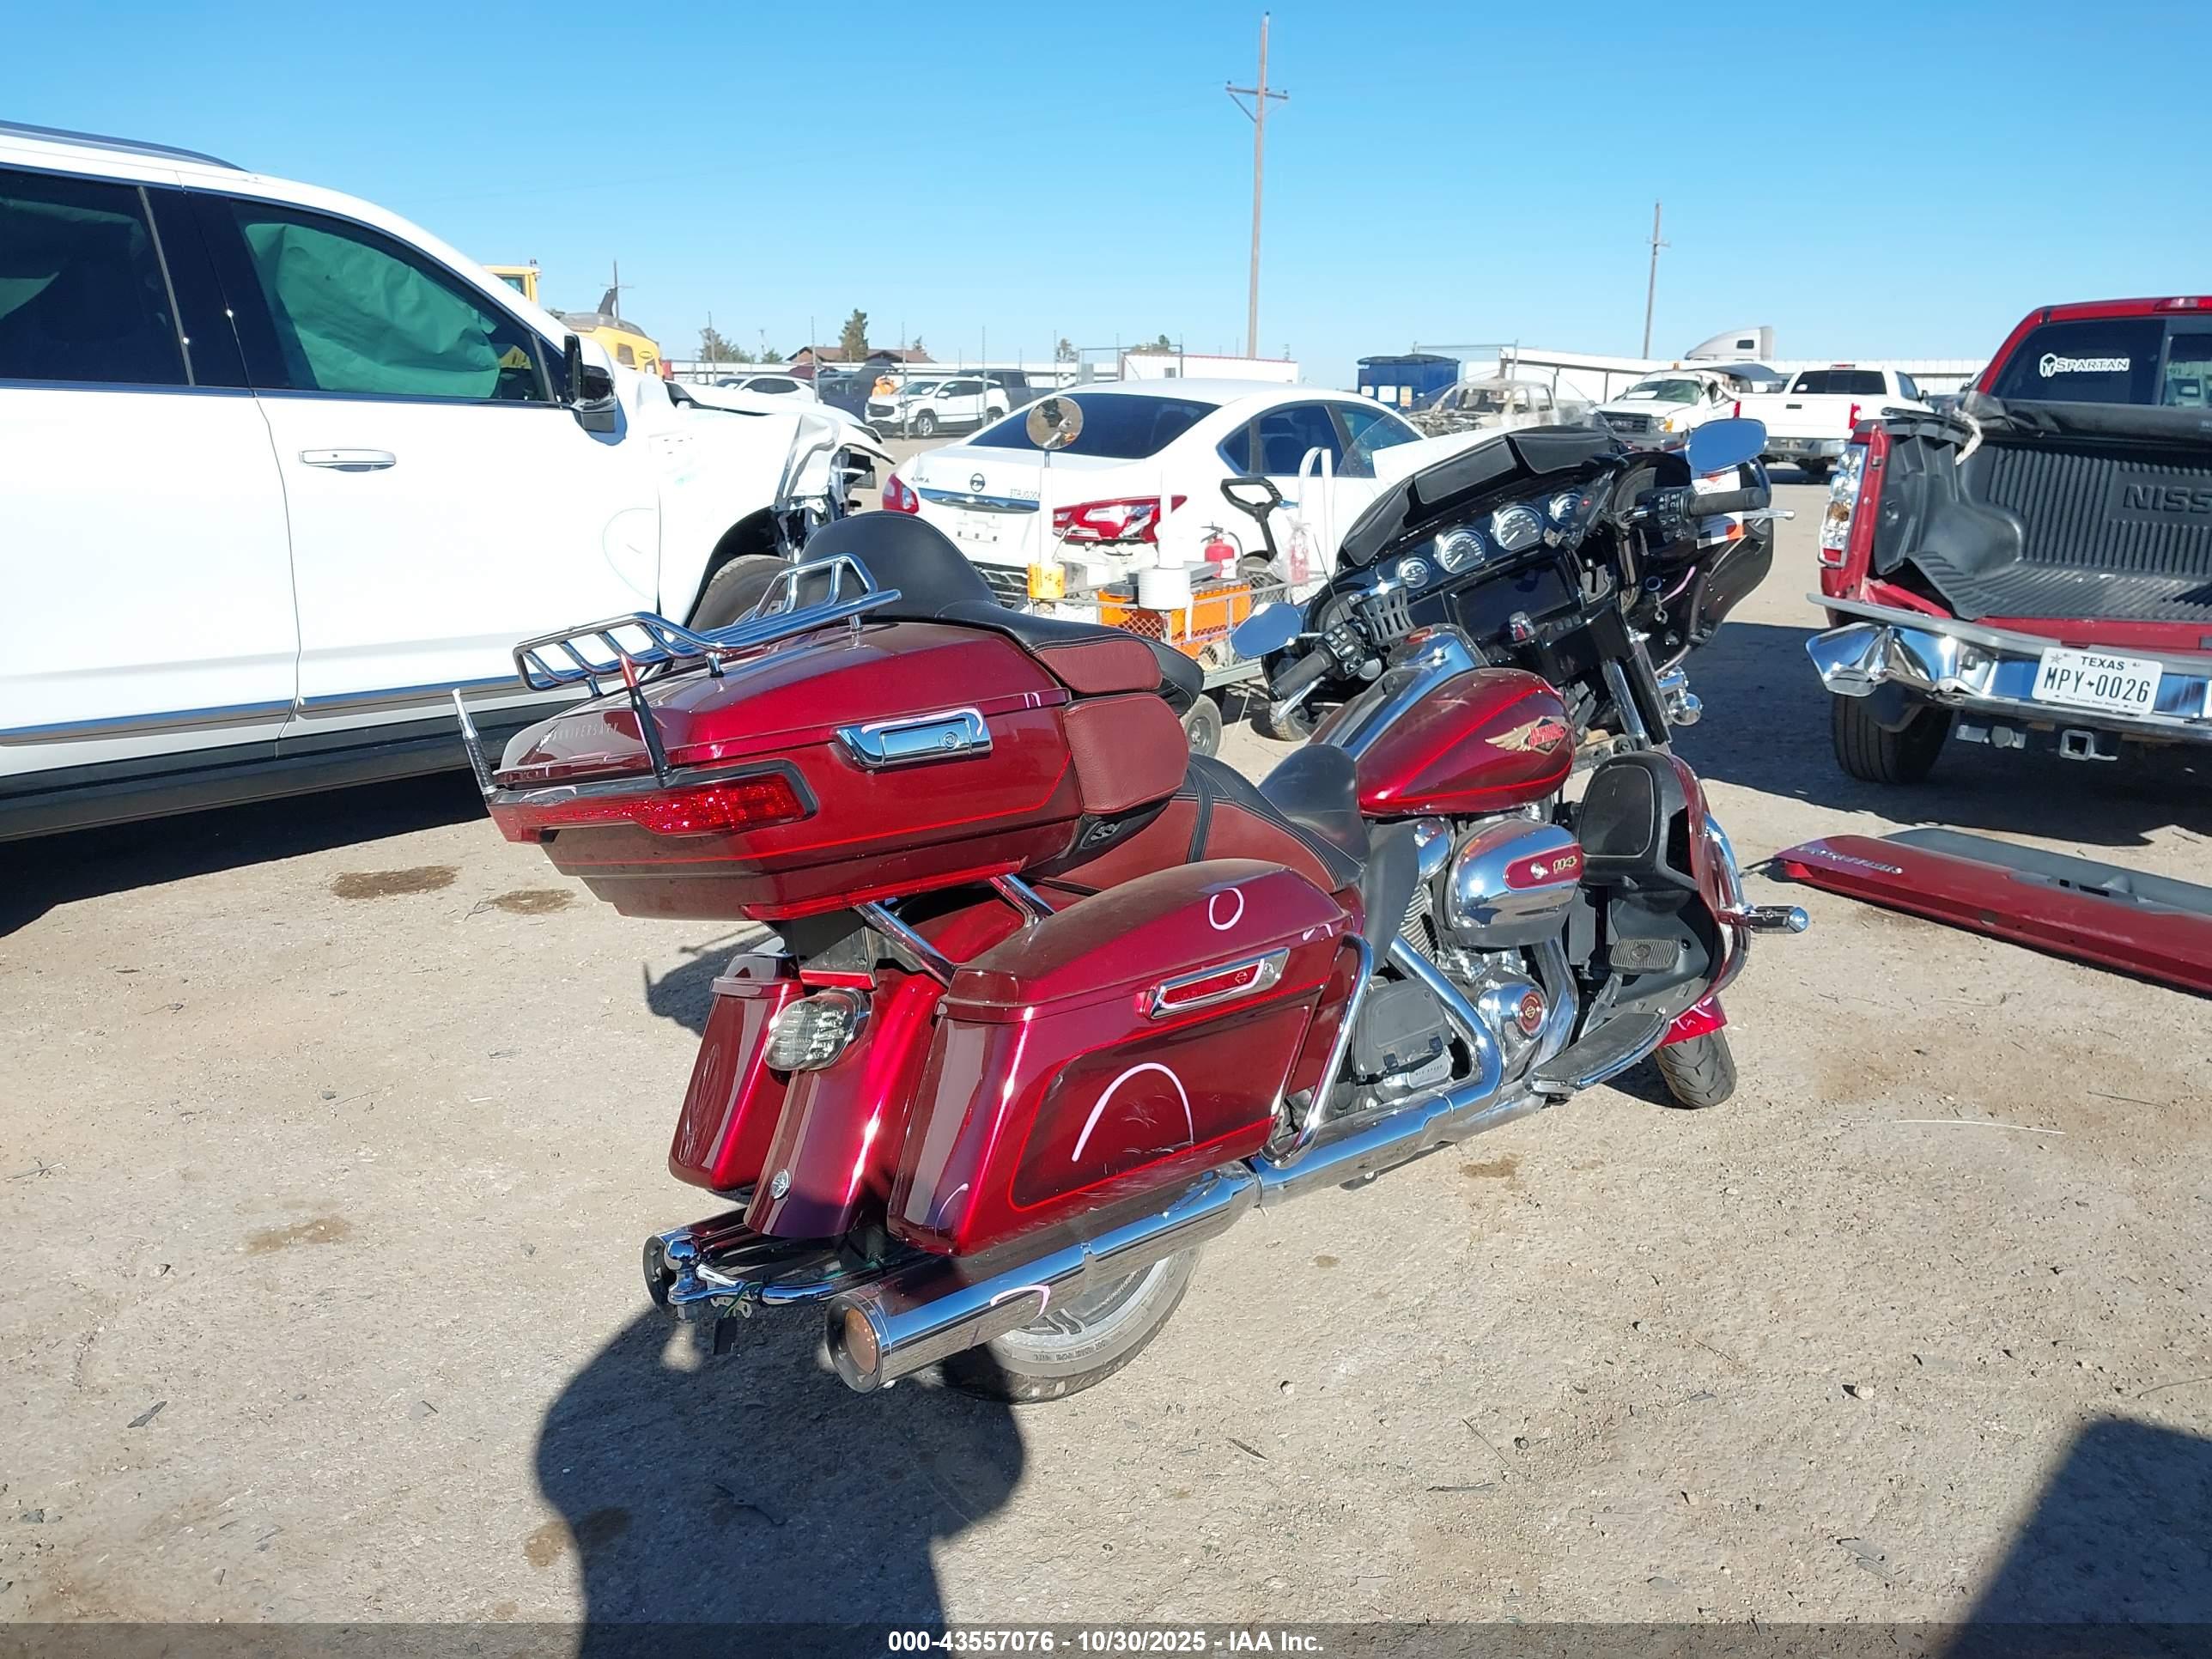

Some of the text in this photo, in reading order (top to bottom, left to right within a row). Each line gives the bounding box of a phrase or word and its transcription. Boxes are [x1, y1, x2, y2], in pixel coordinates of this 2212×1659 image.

[2056, 357, 2130, 372] SPARTAN
[2081, 655, 2125, 672] TEXAS
[1553, 855, 1577, 874] 114
